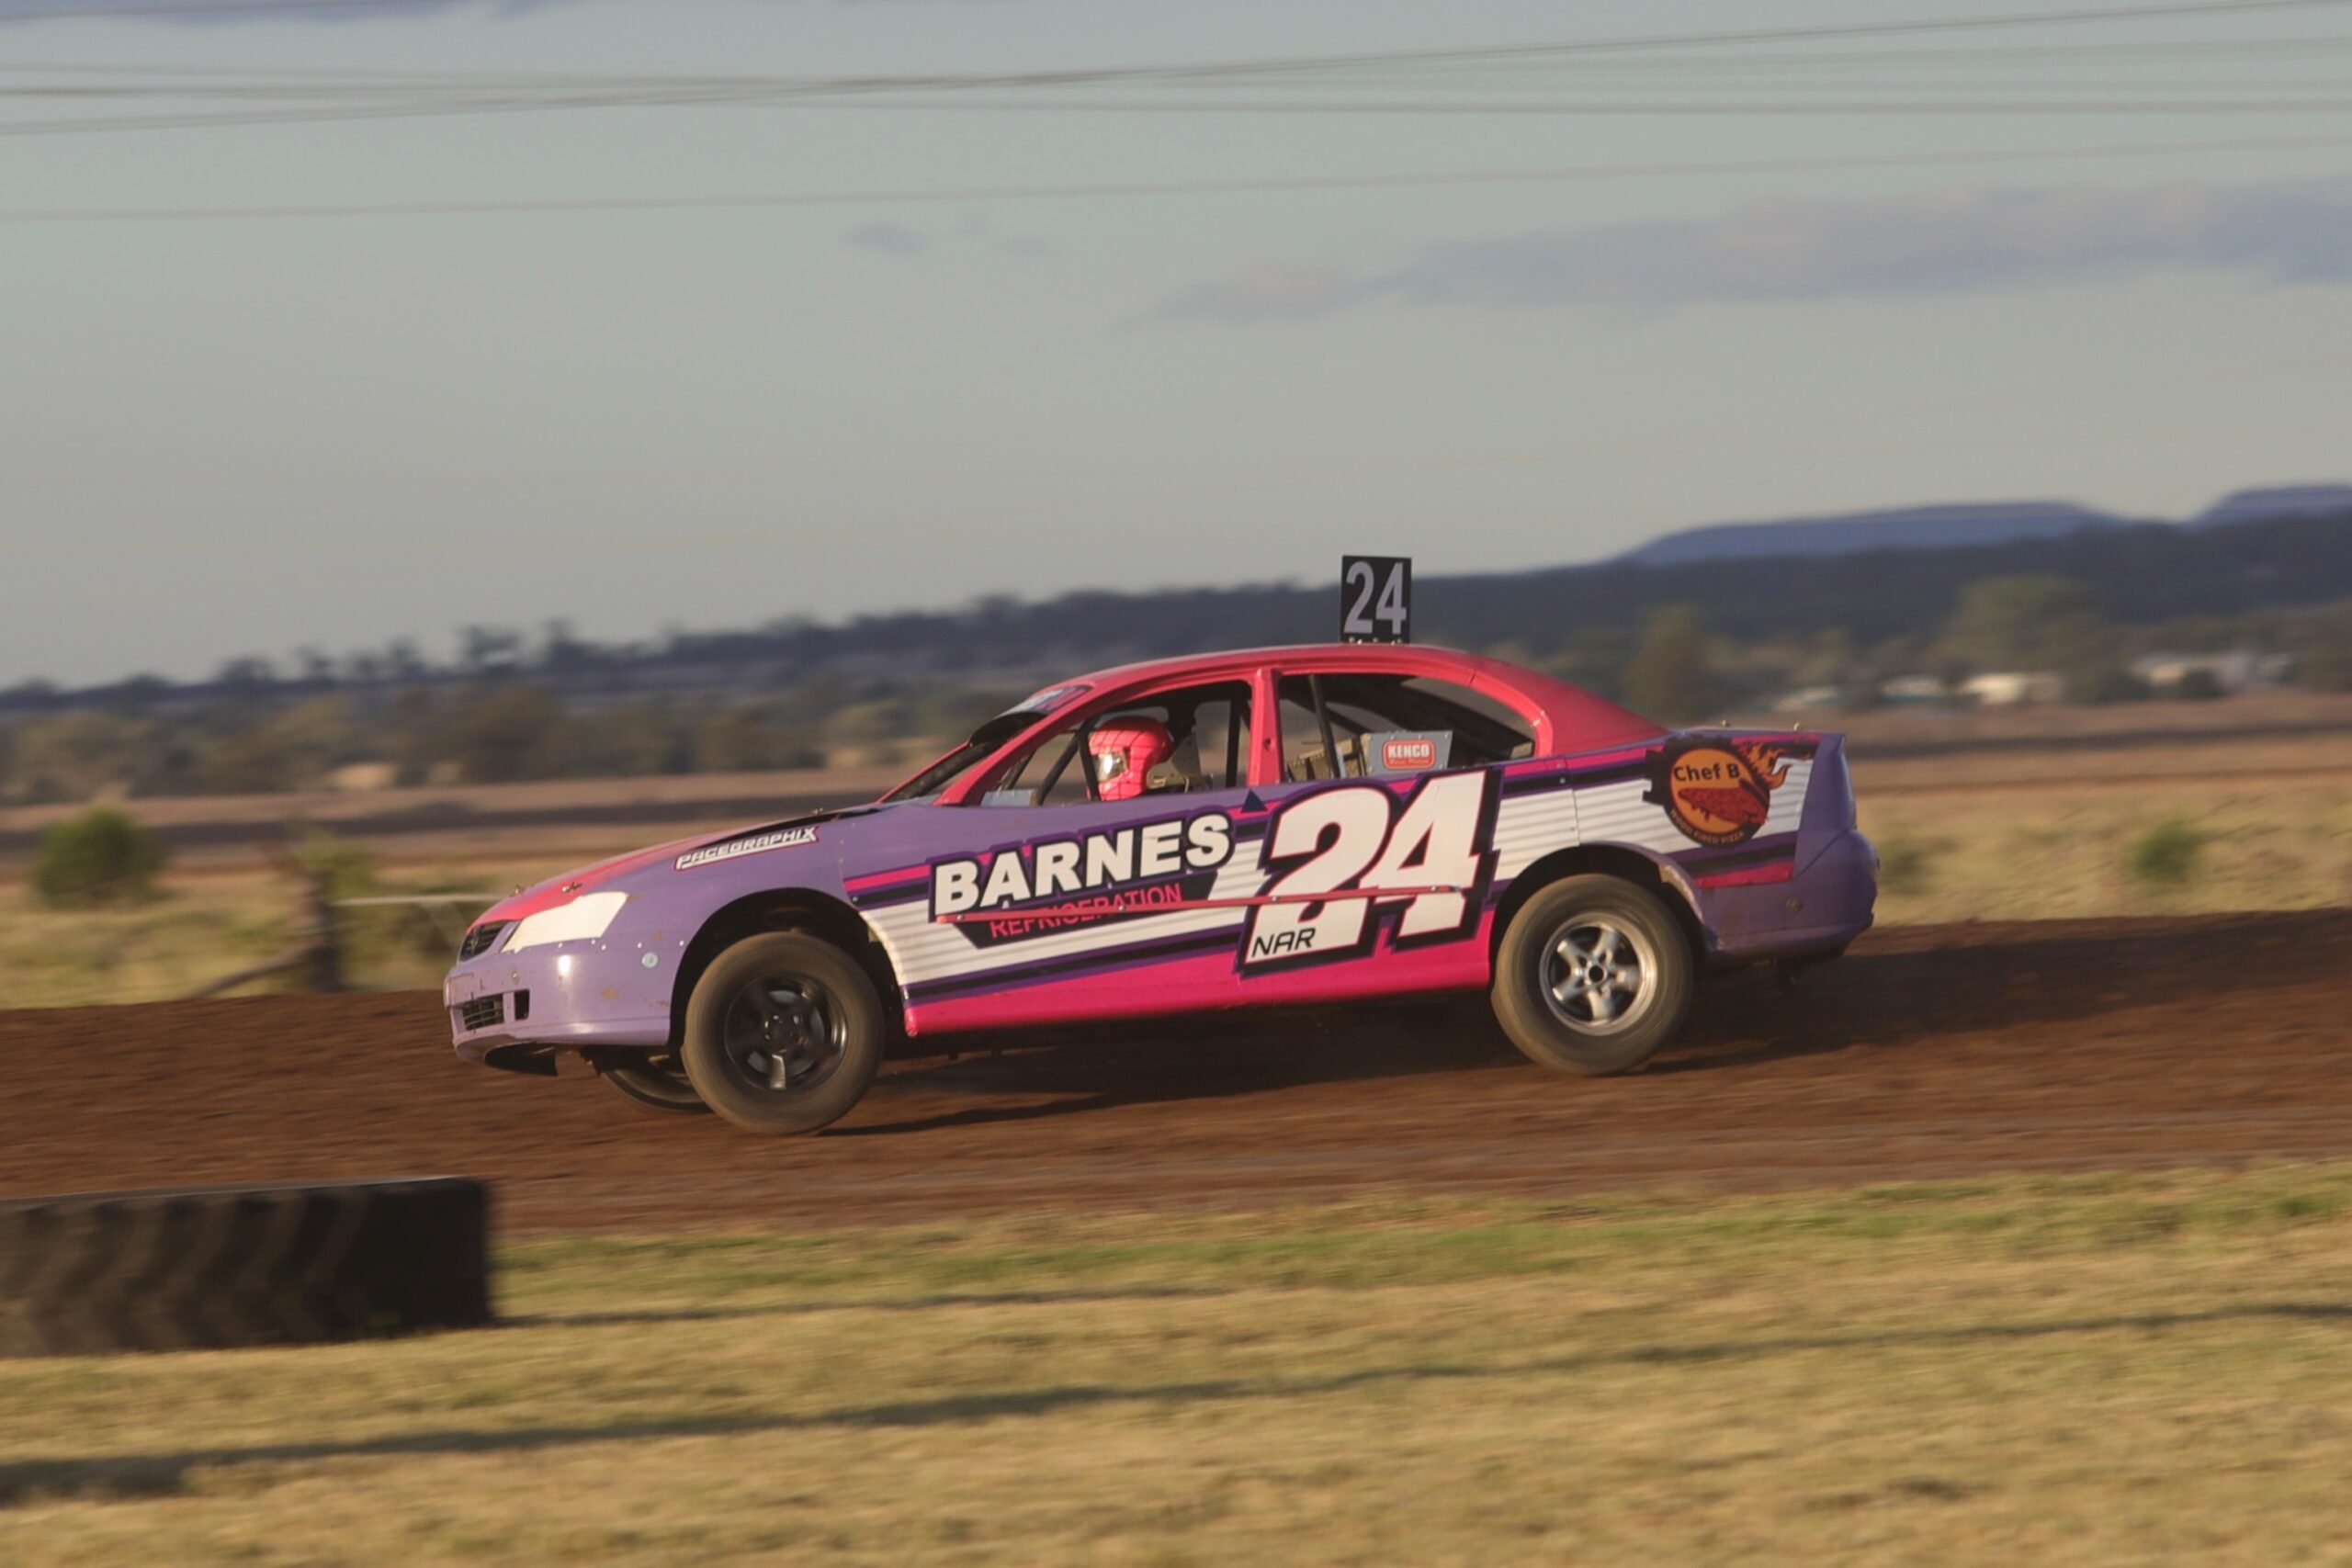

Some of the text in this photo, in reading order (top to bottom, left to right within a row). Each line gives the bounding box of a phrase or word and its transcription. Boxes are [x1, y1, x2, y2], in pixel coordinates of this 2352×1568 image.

[1343, 561, 1407, 635] 24
[1674, 762, 1740, 781] Chef B
[675, 827, 817, 871] PACEGRAPHIX
[934, 814, 1230, 916] BARNES
[1245, 771, 1487, 964] 24
[989, 883, 1182, 939] REFRIGERATION
[1251, 927, 1317, 958] NAR
